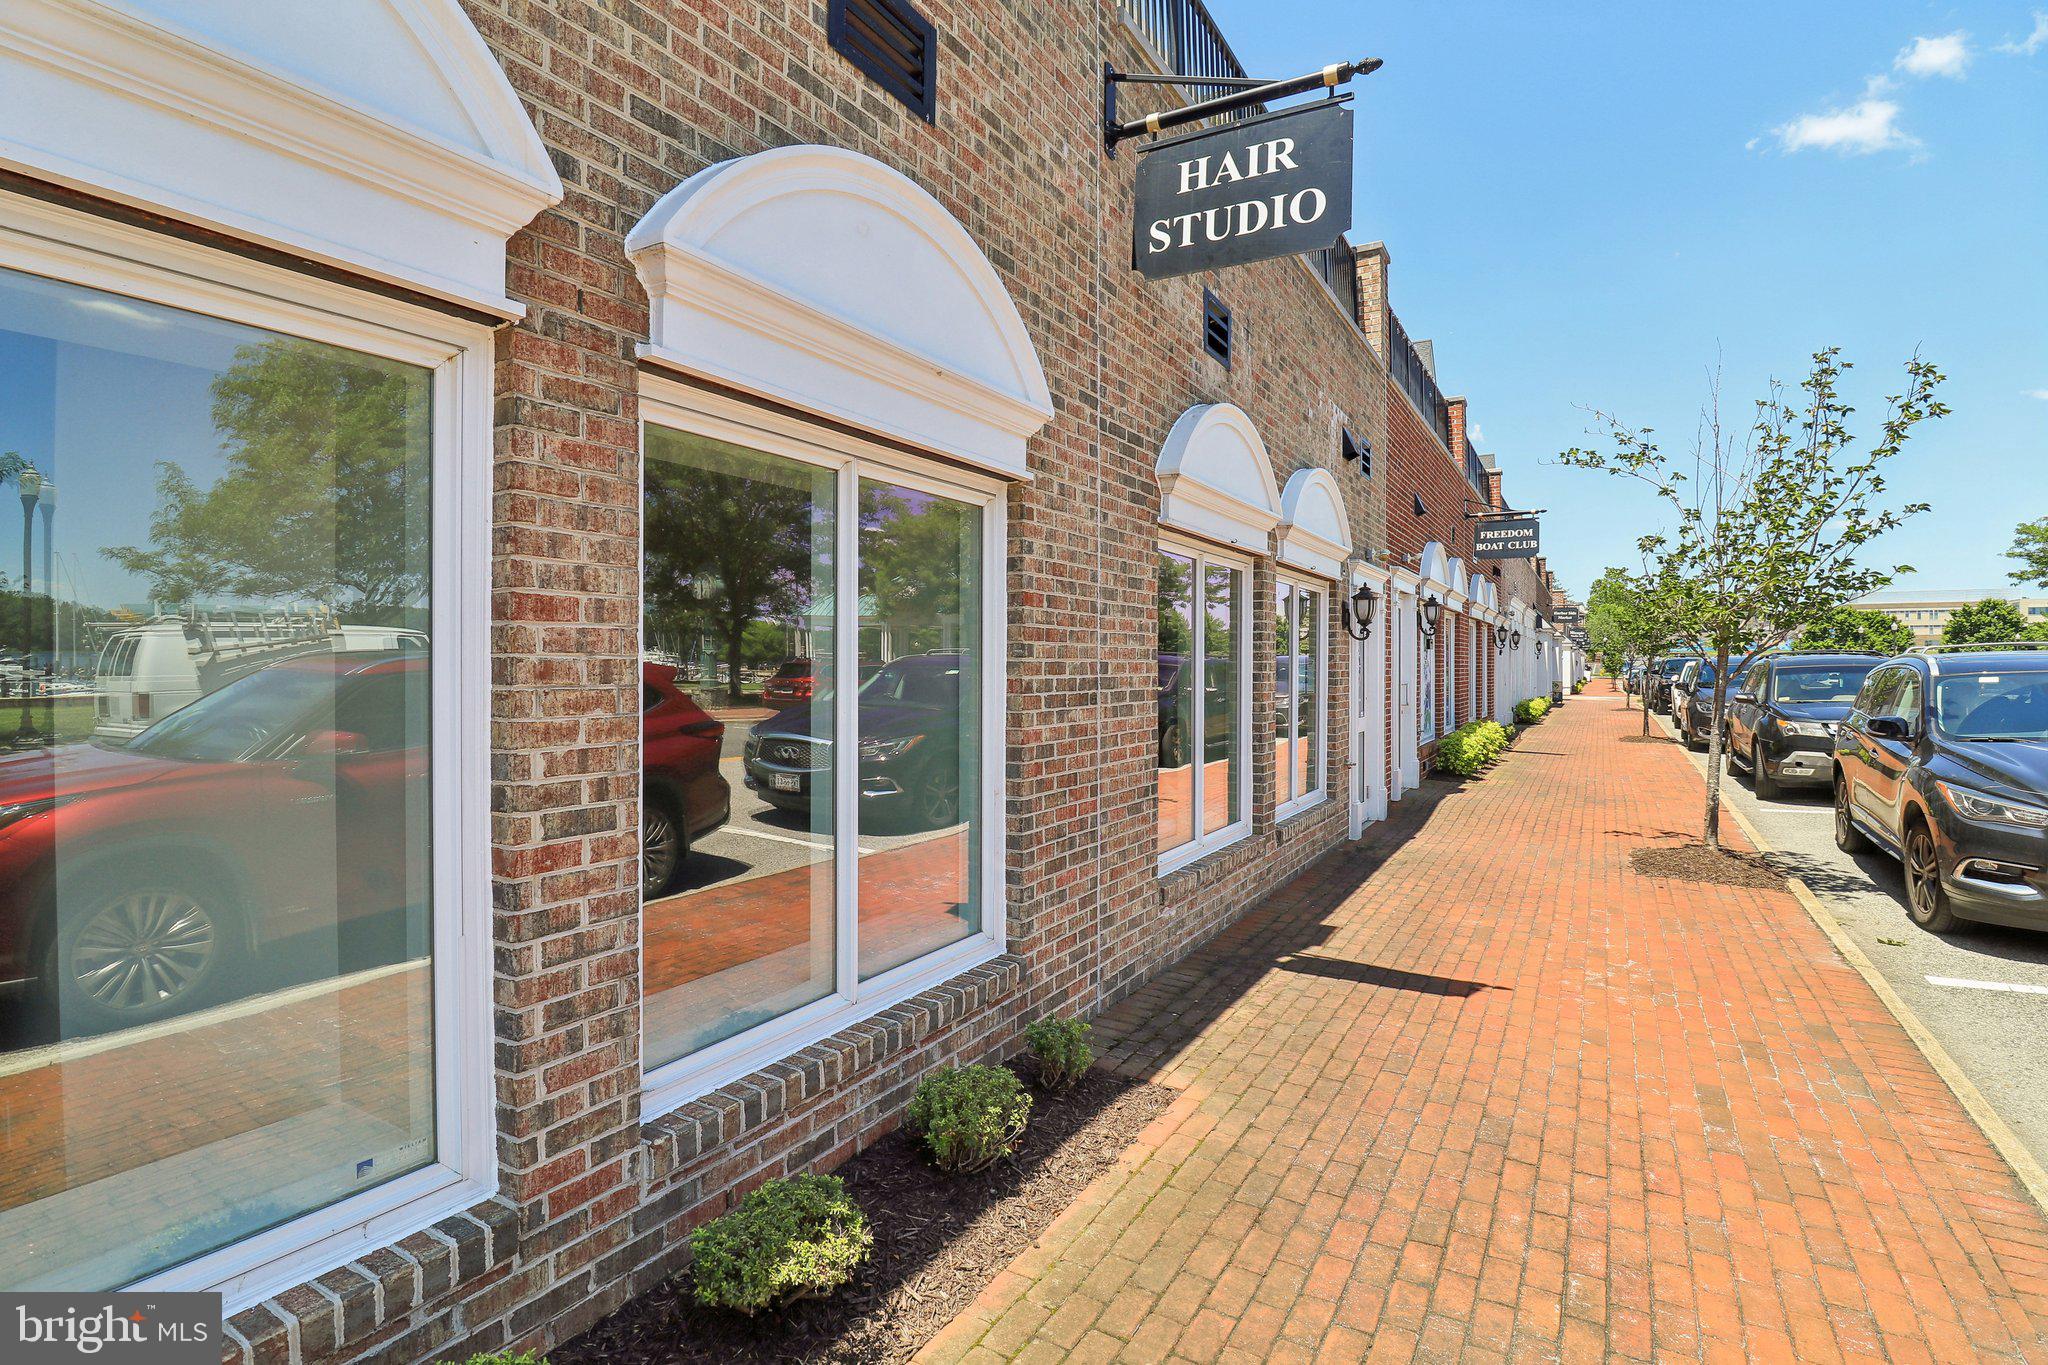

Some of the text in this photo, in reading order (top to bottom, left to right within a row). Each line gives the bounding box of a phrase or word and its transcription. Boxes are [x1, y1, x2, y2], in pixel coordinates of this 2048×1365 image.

[1176, 137, 1299, 195] HAIR
[1149, 187, 1327, 254] STUDIO
[1476, 540, 1538, 551] BOAT CLUB
[1480, 528, 1534, 539] FREEDOM
